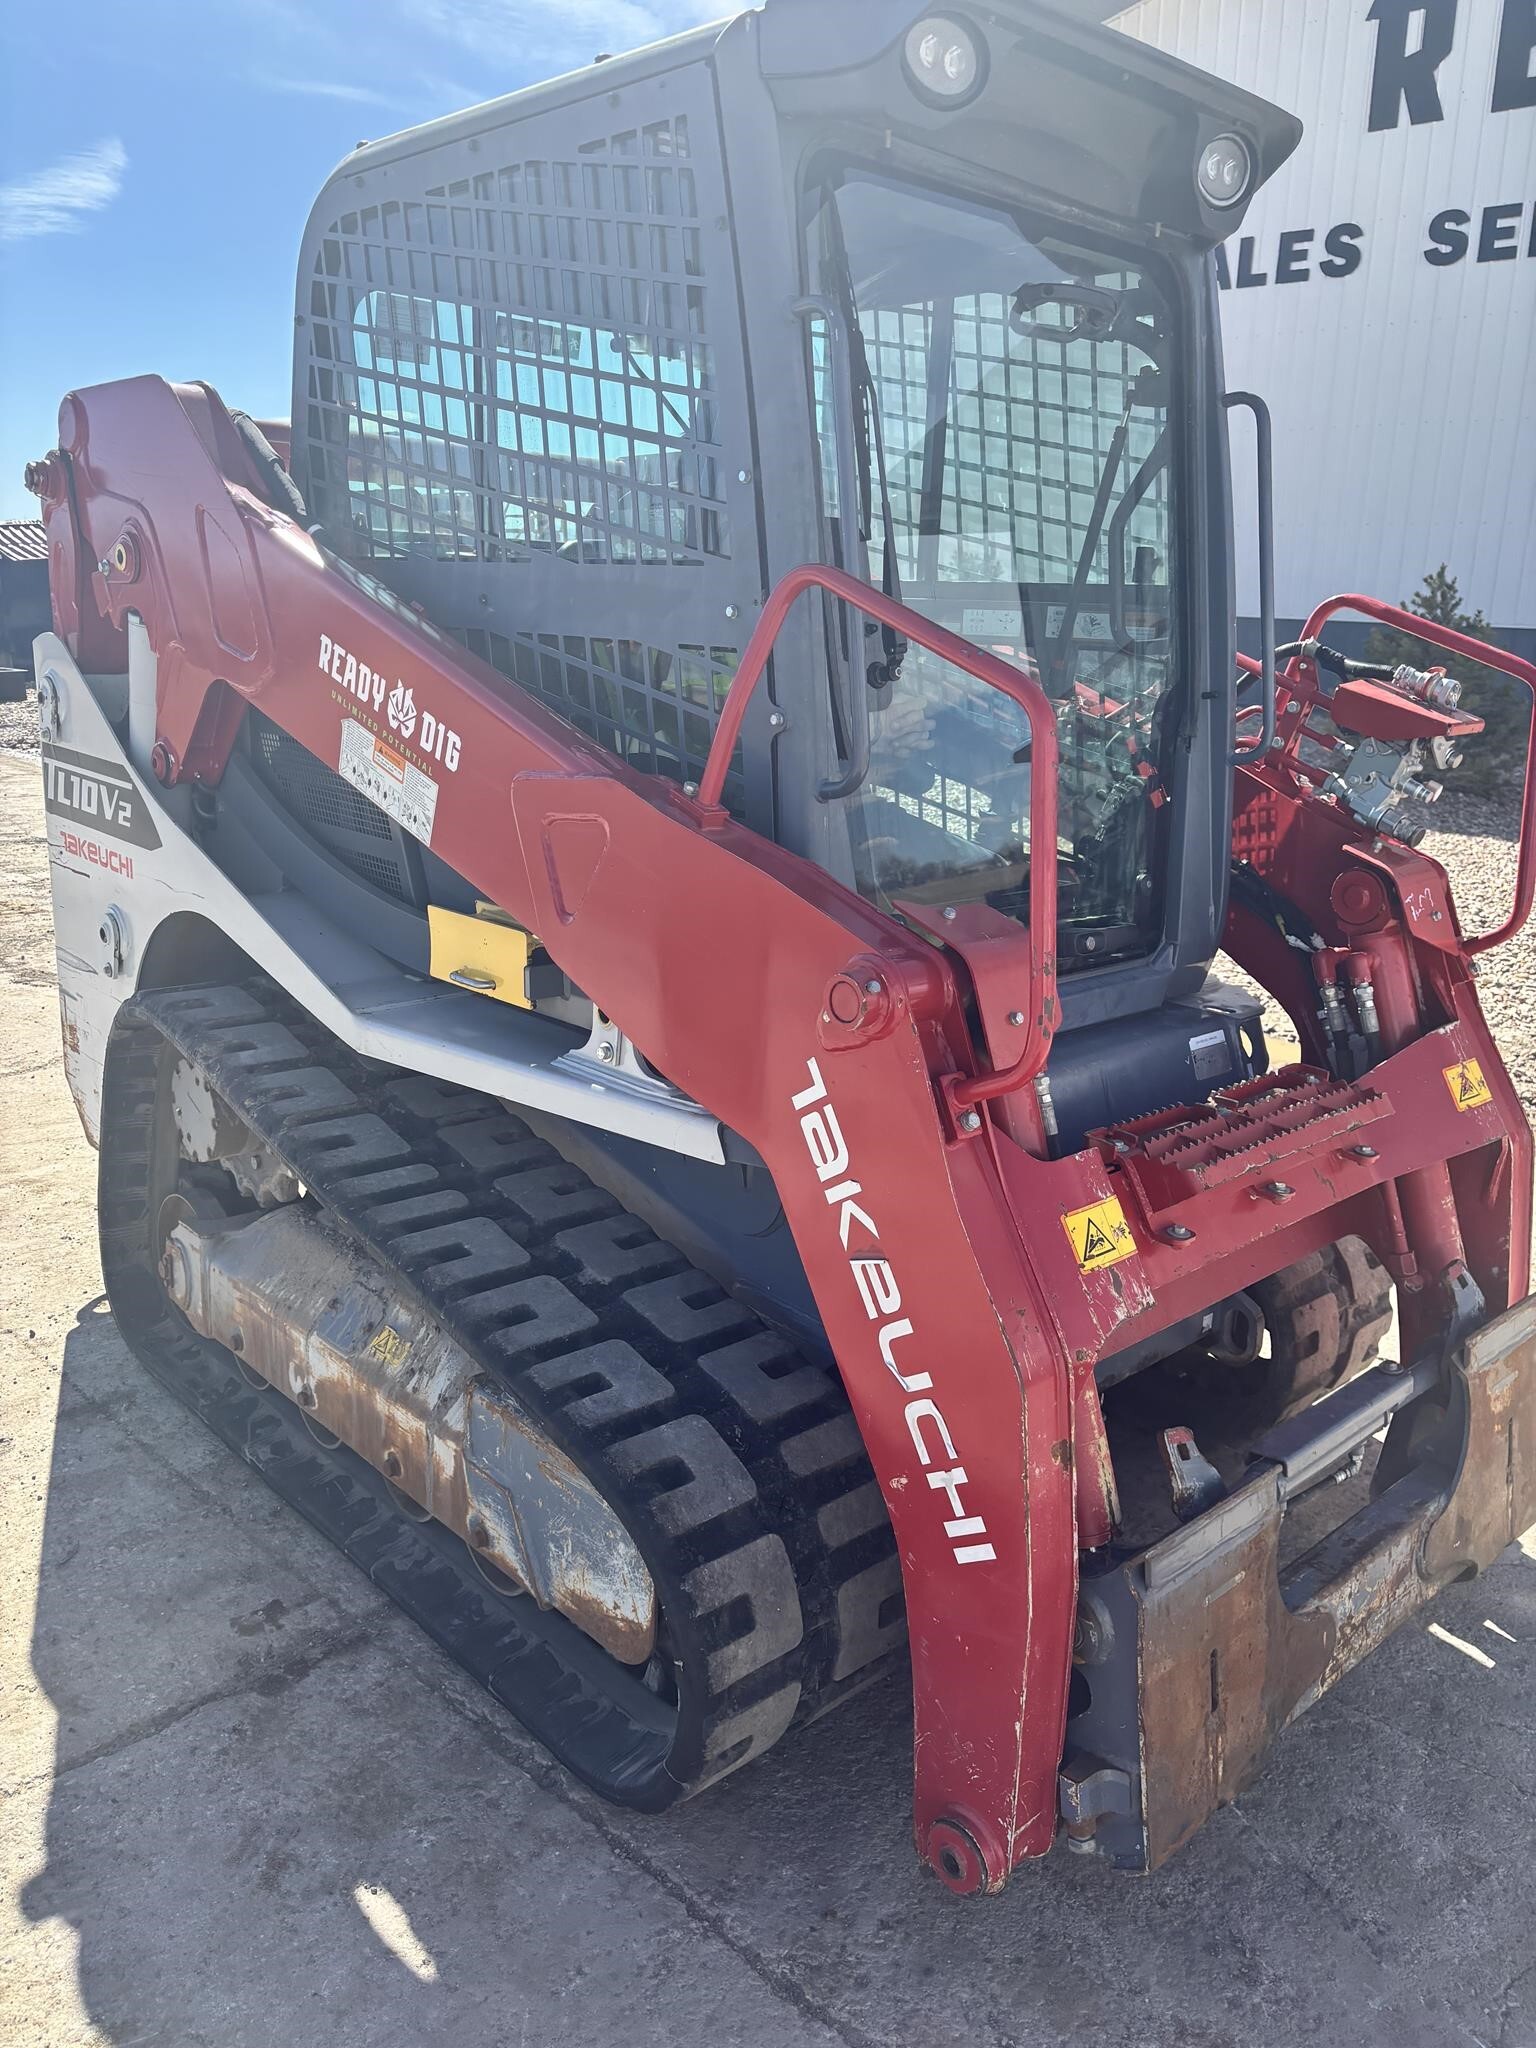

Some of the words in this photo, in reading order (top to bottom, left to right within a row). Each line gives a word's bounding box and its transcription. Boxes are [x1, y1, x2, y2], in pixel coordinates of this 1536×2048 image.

[1423, 201, 1536, 266] SE
[318, 633, 387, 712] READY
[419, 710, 462, 773] DIG
[331, 689, 379, 732] UNLIMITED
[382, 729, 433, 777] POTENTIAL
